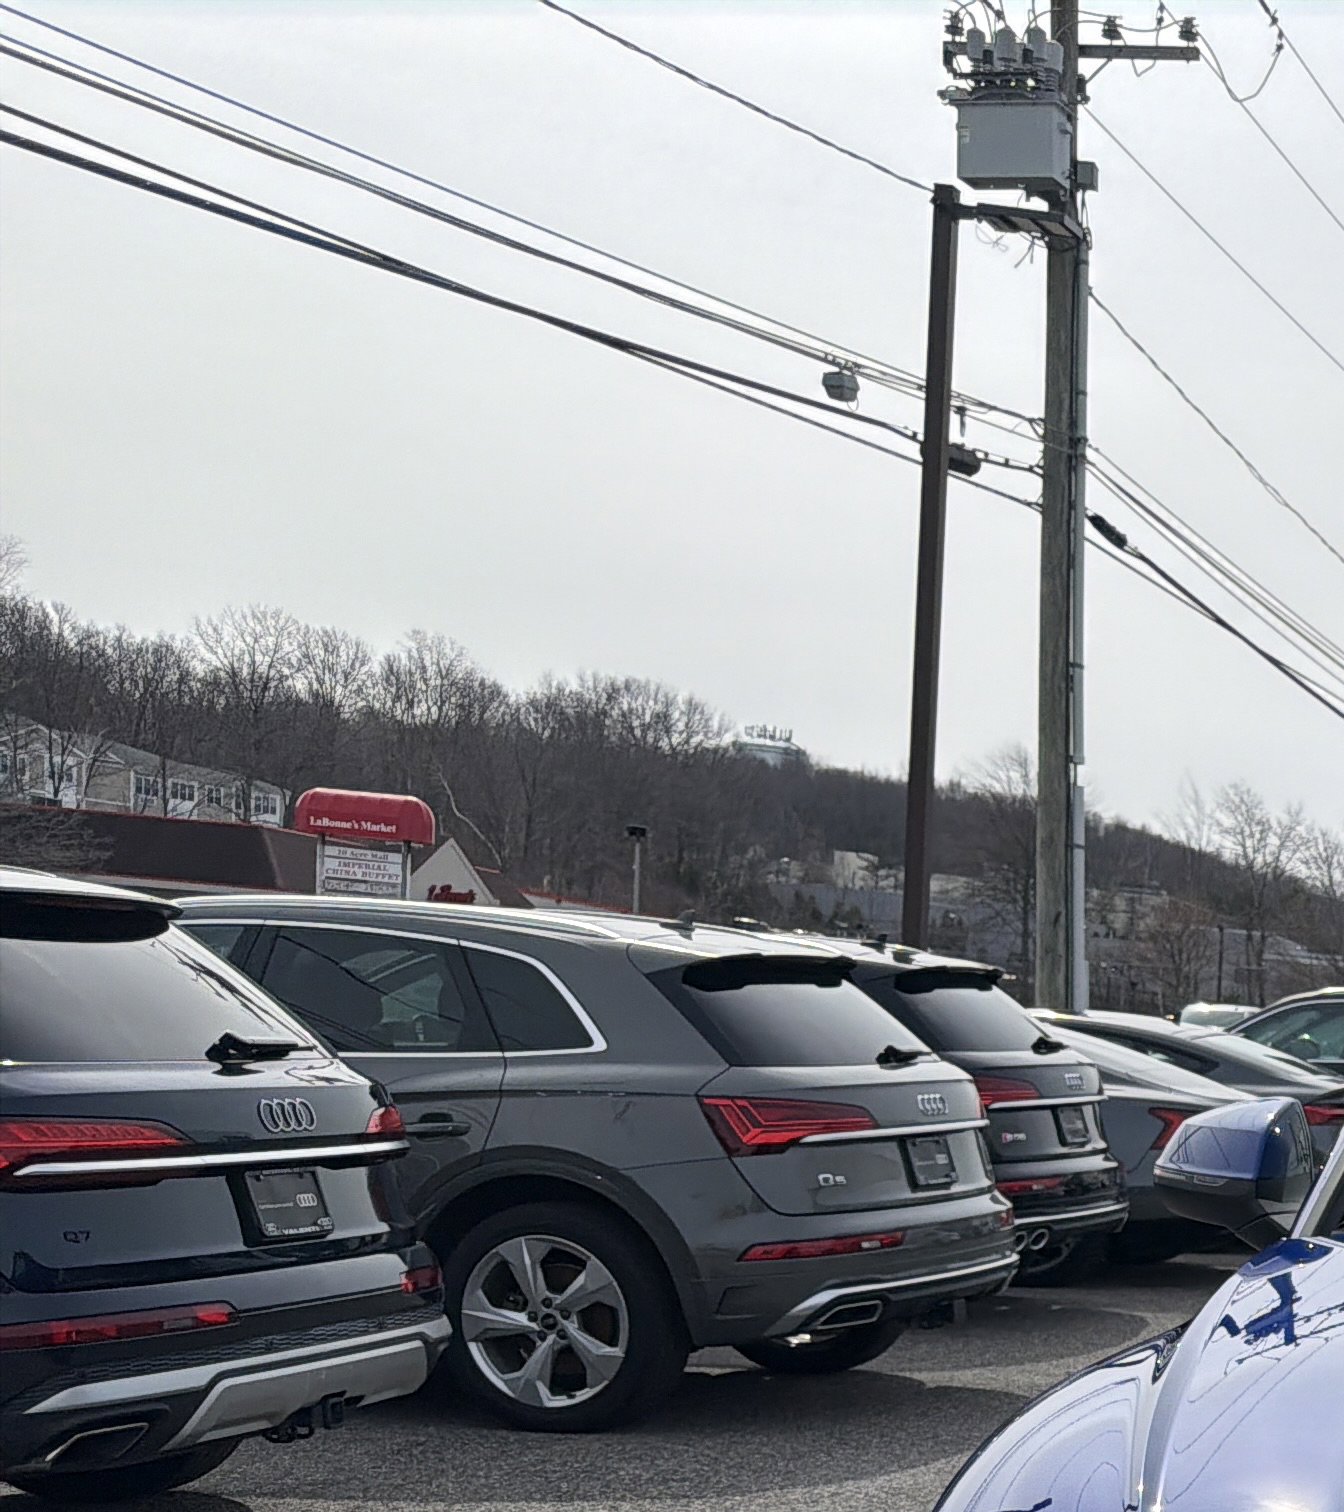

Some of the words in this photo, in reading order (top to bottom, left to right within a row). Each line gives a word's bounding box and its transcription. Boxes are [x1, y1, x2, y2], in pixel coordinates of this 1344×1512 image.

[309, 816, 359, 830] LaBonne's
[361, 820, 397, 833] Market
[337, 861, 389, 872] IMPERIAL
[325, 868, 358, 877] CHINA
[361, 871, 400, 881] BUFFET
[818, 1173, 847, 1186] Q5
[63, 1230, 90, 1244] Q7
